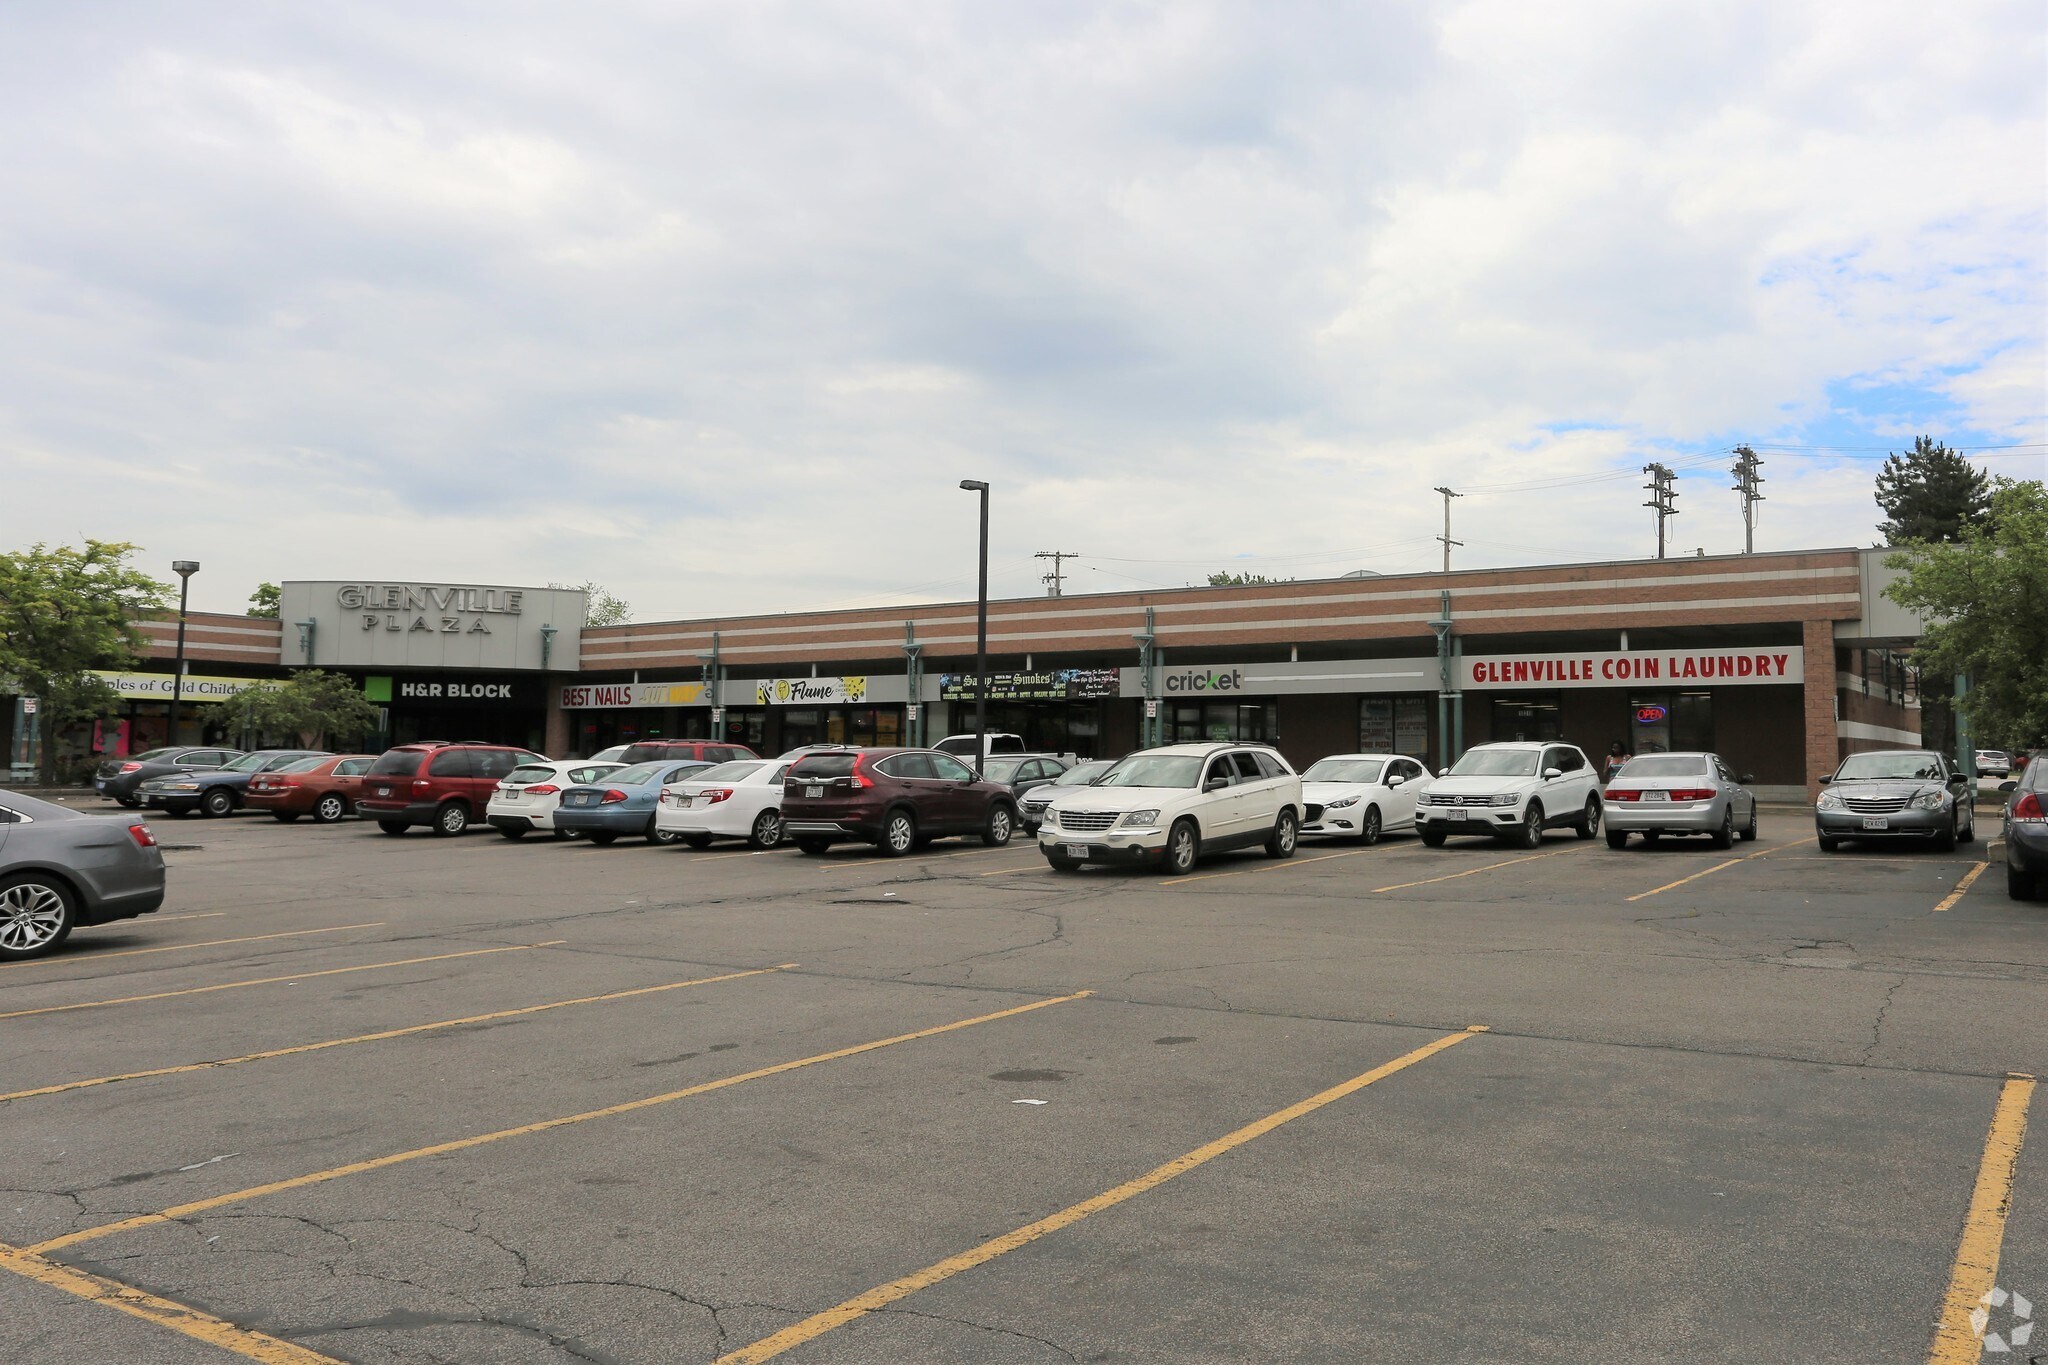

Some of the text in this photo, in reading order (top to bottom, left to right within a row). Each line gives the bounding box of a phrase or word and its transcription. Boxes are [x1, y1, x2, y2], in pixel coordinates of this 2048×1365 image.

[337, 585, 523, 615] GLENVILLE
[362, 614, 492, 635] PLAZA
[1472, 654, 1789, 683] GLENVILLE COIN LAUNDRY
[106, 677, 136, 694] ples
[140, 680, 156, 691] of
[161, 681, 194, 692] Gld
[401, 683, 512, 698] H&R BLOCK
[963, 675, 992, 689] Say
[1166, 669, 1241, 692] cricket
[563, 687, 632, 706] BEST NAILS
[640, 684, 705, 704] SUBWAY
[791, 681, 834, 702] Flame
[1637, 709, 1663, 720] OPEN
